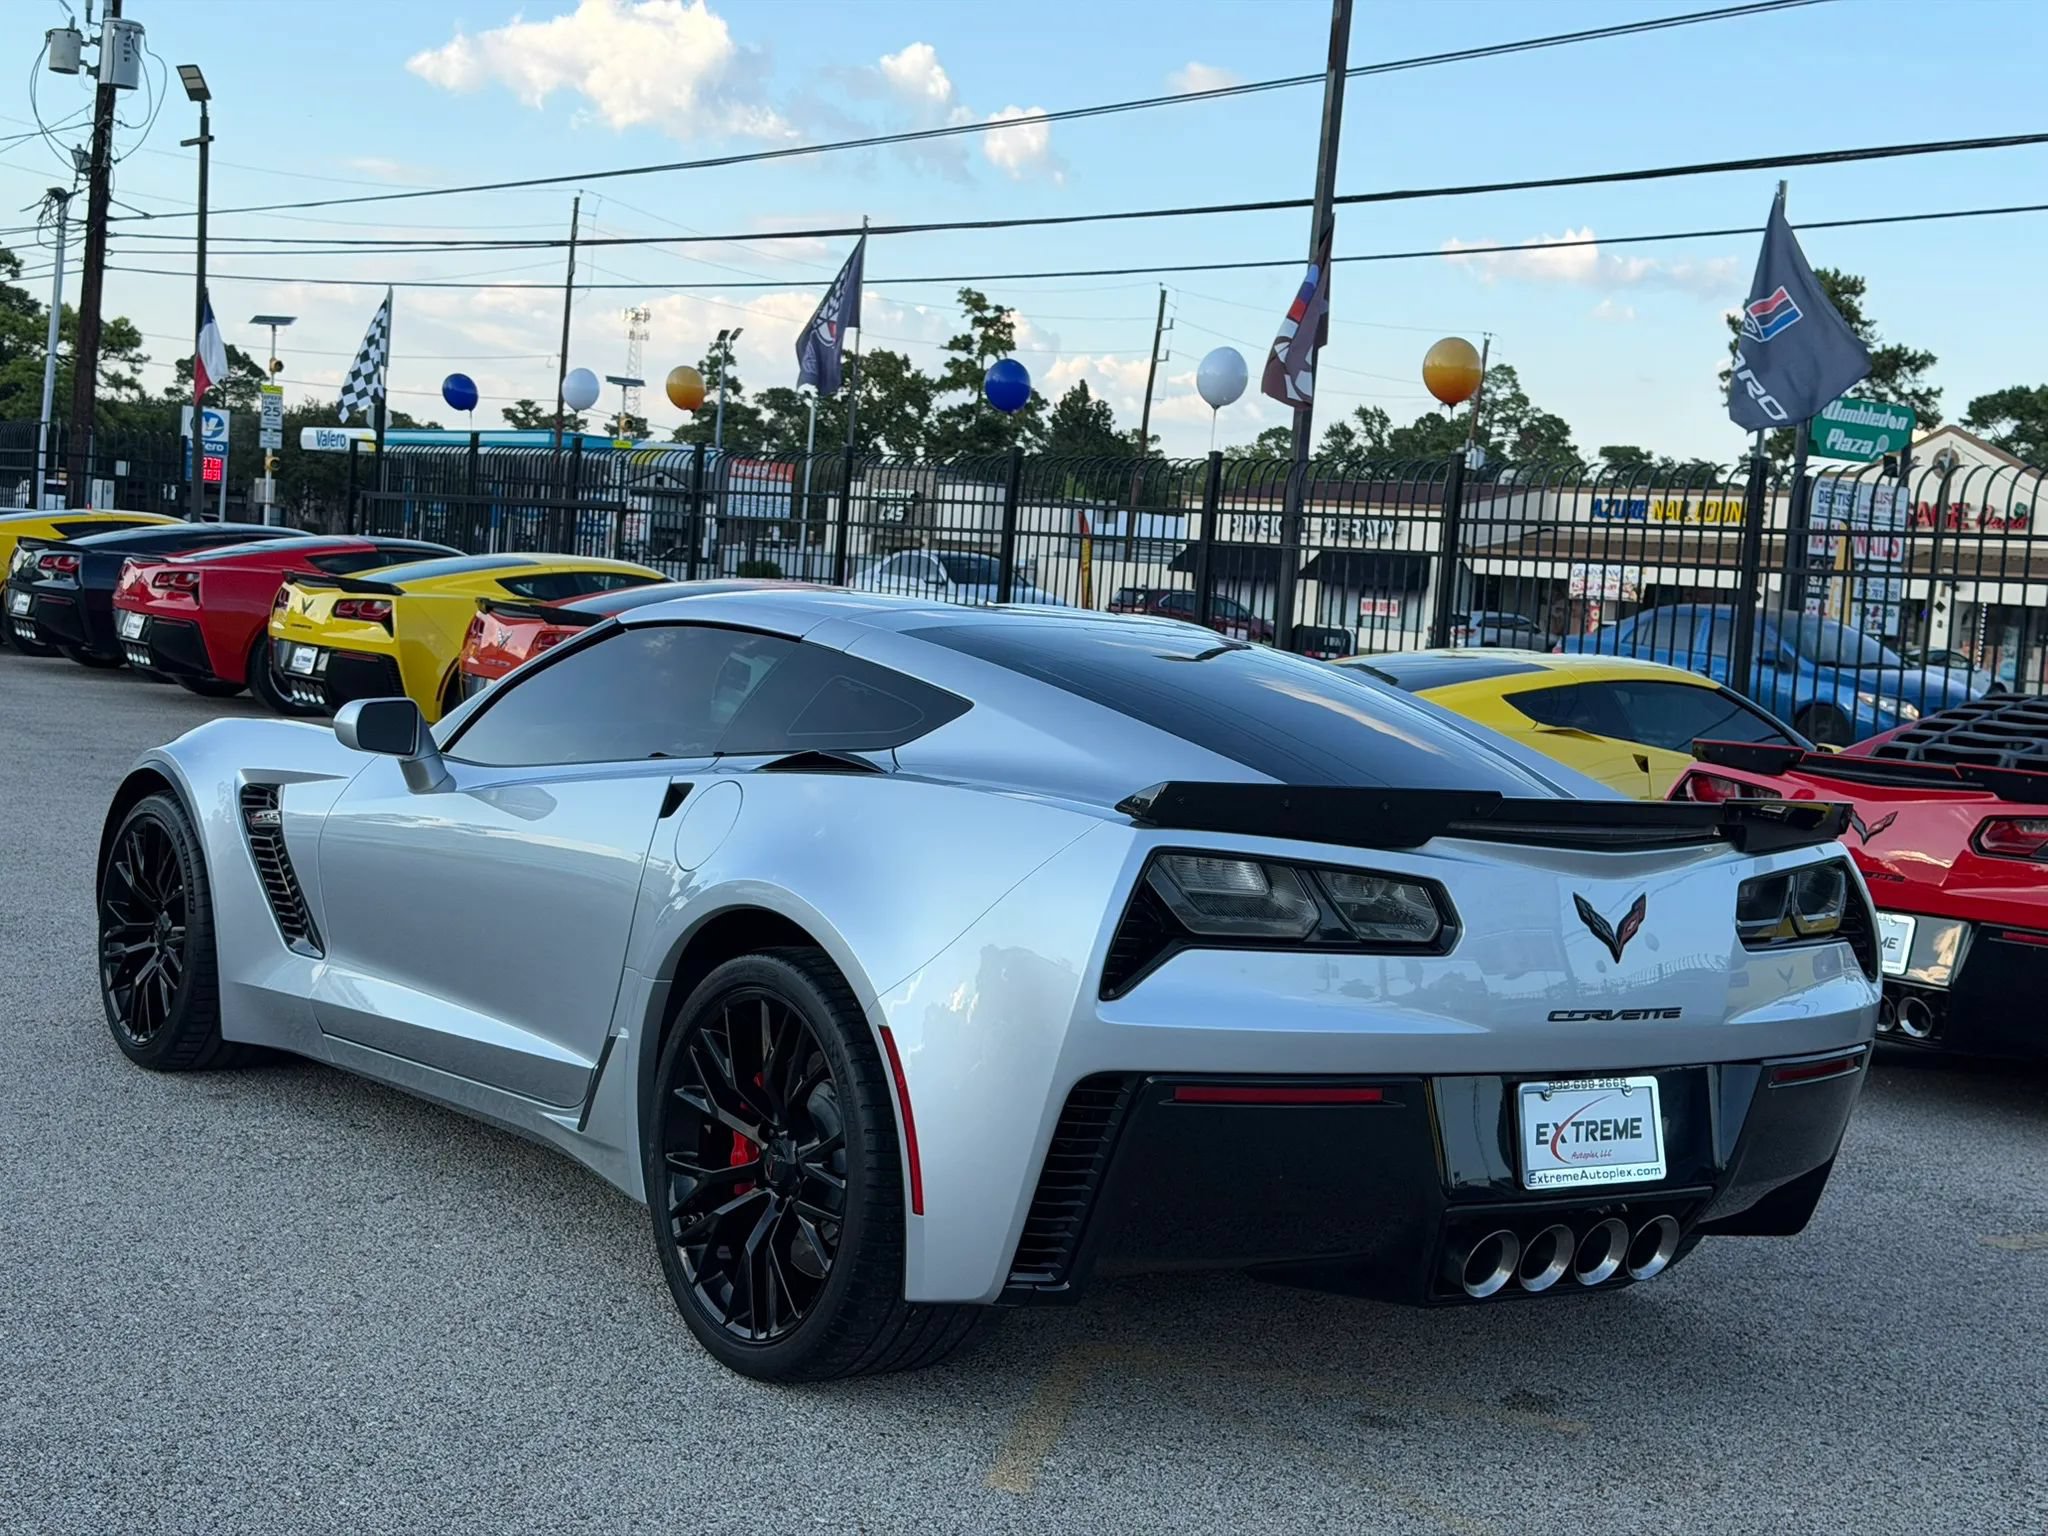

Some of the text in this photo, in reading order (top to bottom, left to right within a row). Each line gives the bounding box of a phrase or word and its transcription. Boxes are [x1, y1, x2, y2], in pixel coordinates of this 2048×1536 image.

[263, 406, 281, 417] 25
[1822, 400, 1909, 431] Wimbledon
[315, 430, 347, 447] Valero
[1826, 428, 1874, 455] Plaza
[1818, 490, 1856, 507] DETIS
[1232, 514, 1309, 538] PHYSICL
[1547, 1007, 1682, 1022] CORVETTE
[1535, 1117, 1643, 1146] EXTREME
[1528, 1166, 1662, 1184] ExtremeAutoplex.com
